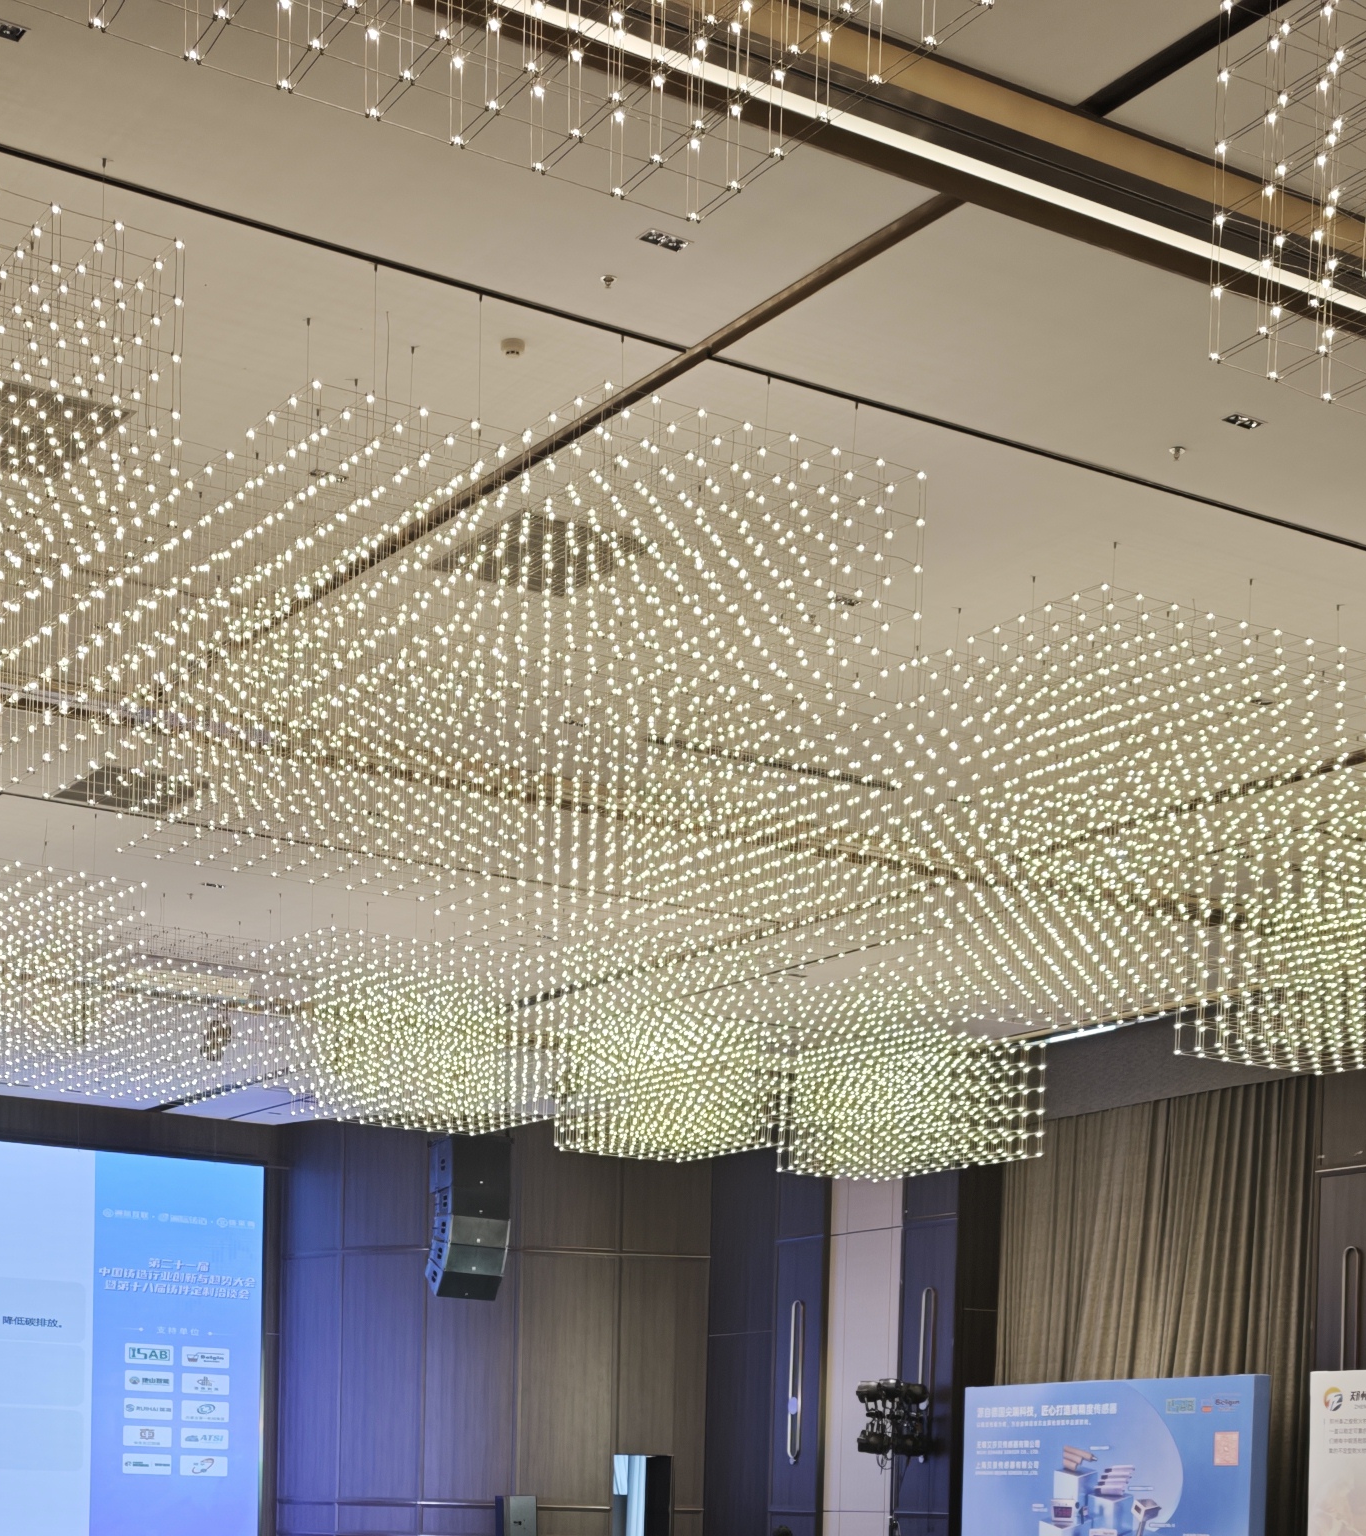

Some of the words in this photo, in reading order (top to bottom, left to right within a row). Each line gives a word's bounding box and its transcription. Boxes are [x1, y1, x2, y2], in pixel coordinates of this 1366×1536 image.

[149, 1257, 210, 1273] 第二十一届
[98, 1266, 256, 1288] 中国铸造行业创新与趋势大会
[104, 1279, 250, 1300] 暨第十八届铸件定制洽谈会
[156, 1325, 200, 1337] 支持单位
